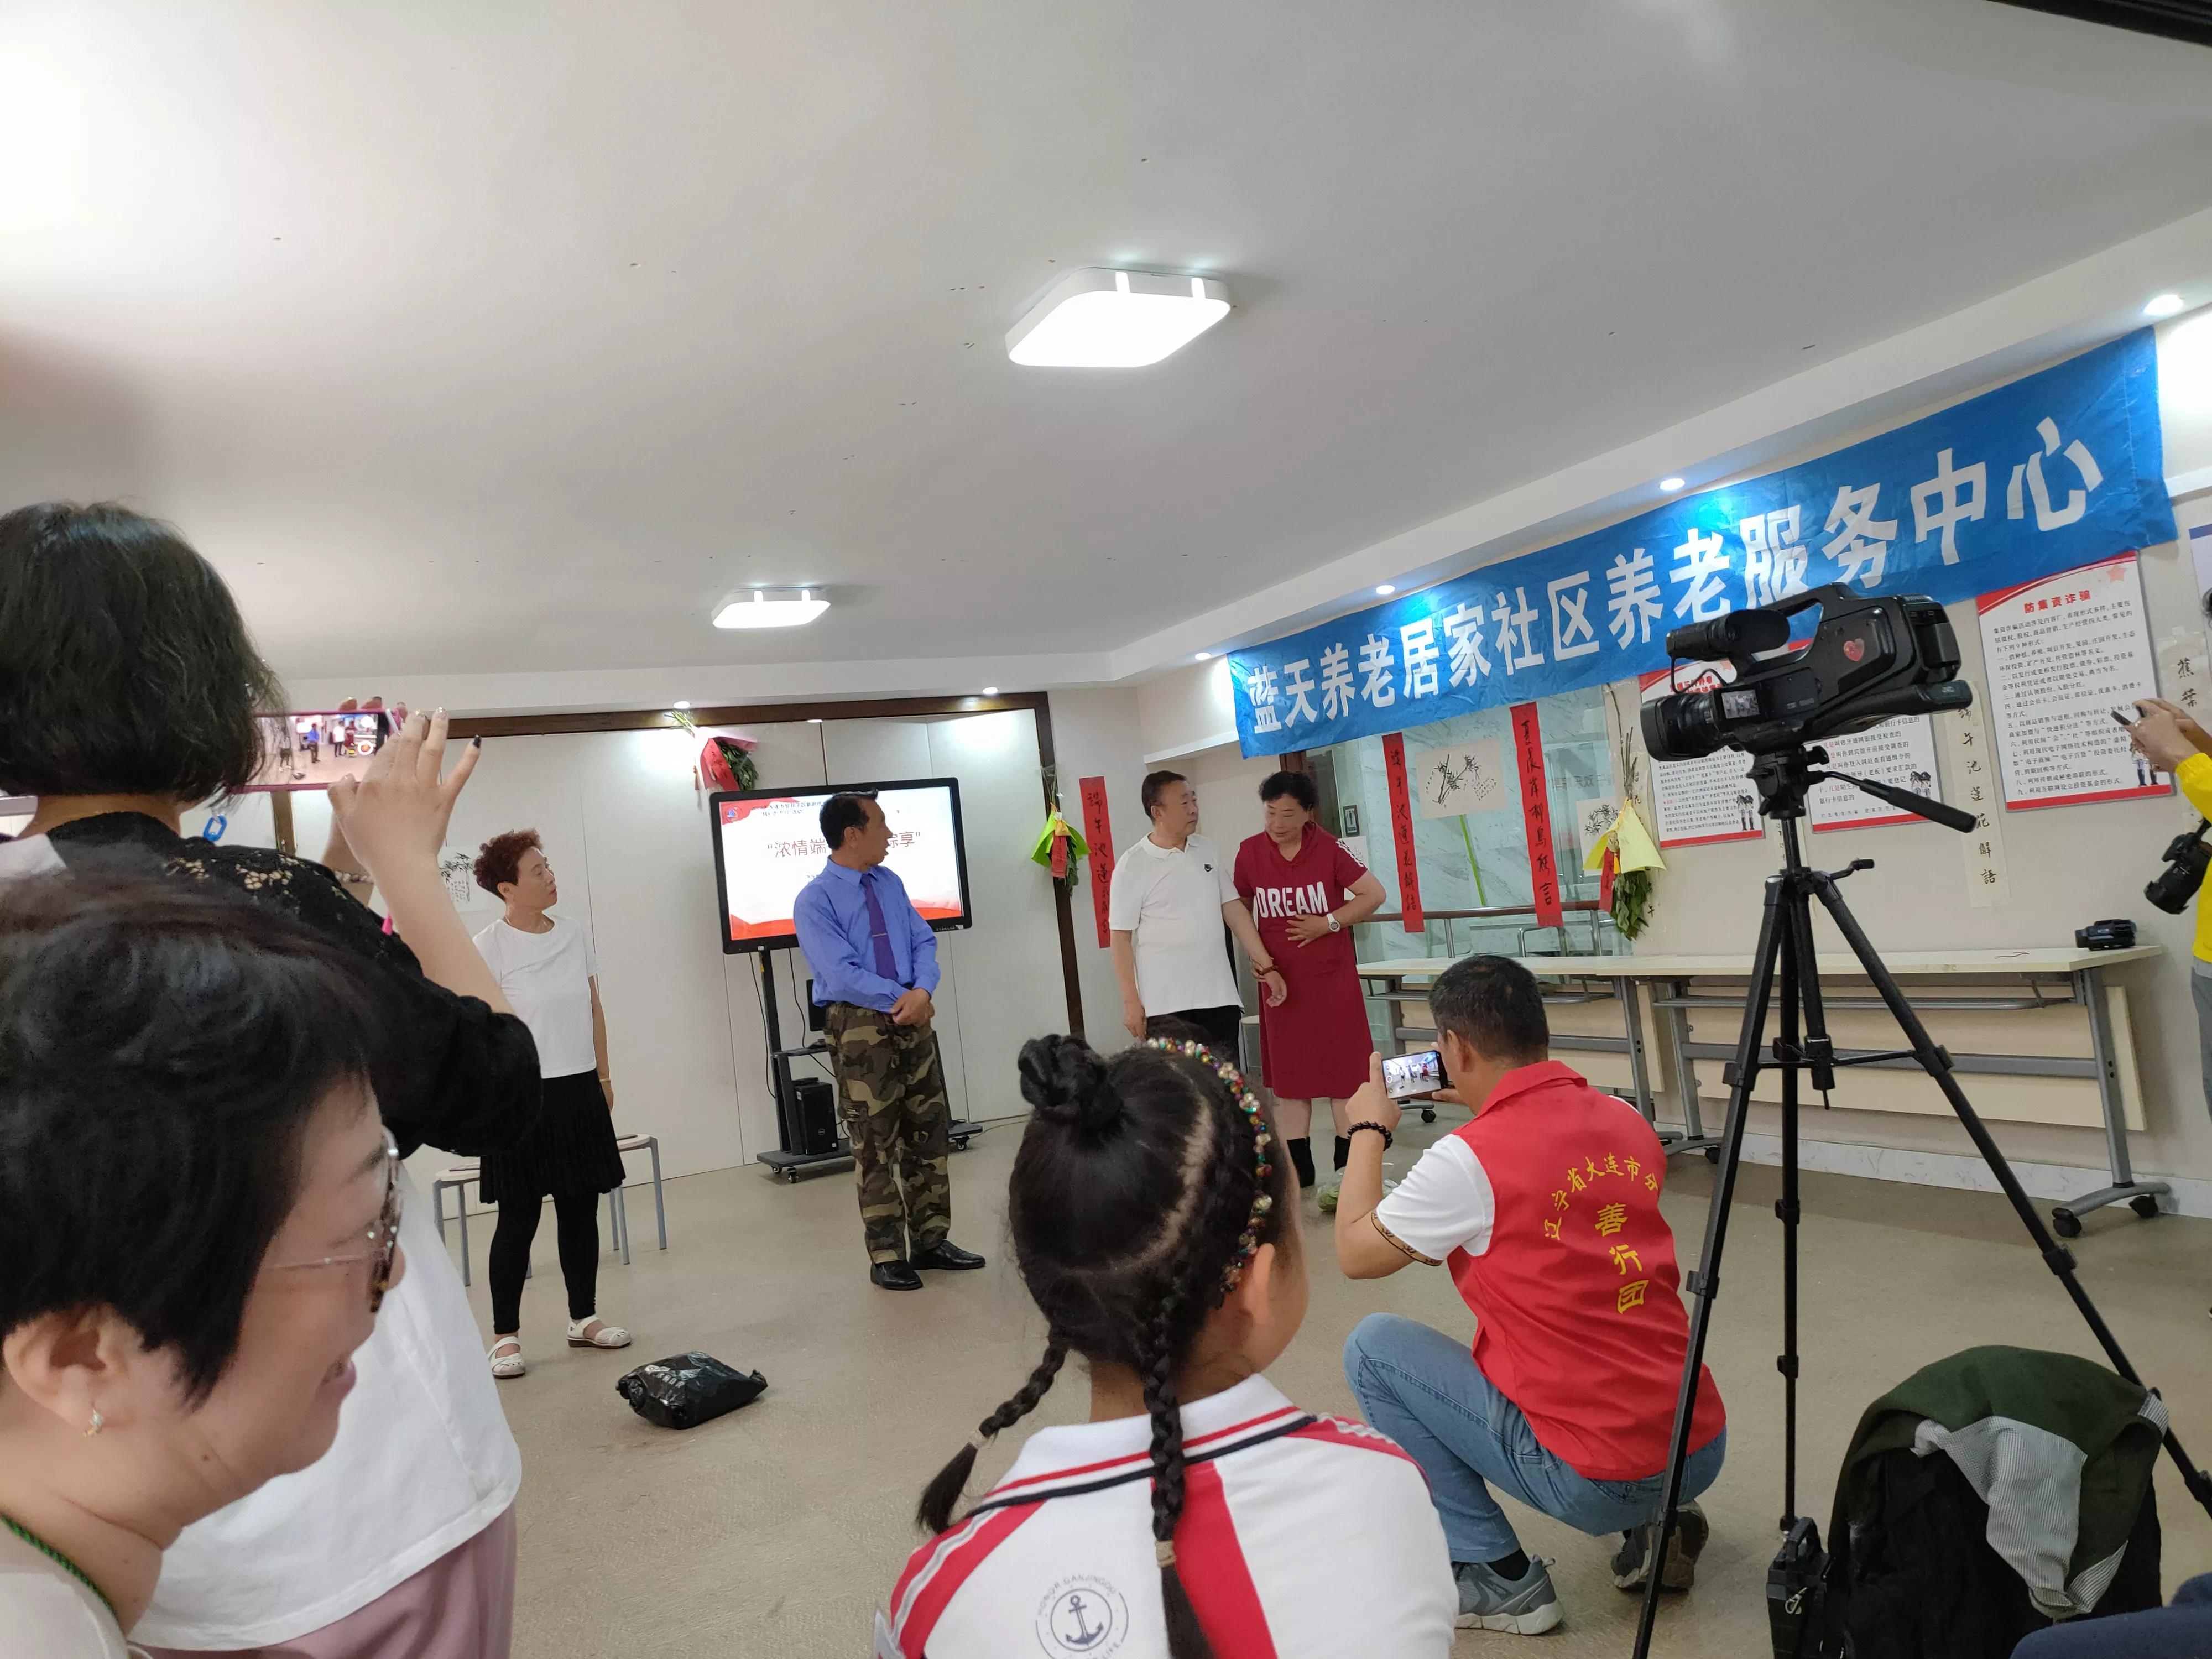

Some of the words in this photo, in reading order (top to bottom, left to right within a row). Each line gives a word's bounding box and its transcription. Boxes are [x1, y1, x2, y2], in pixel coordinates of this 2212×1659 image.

[1251, 414, 2104, 737] 蓝天养老居家社区养老服务中心
[2024, 589, 2091, 614] 防集资诈骗
[1255, 881, 1329, 919] DREAM
[1595, 1202, 1650, 1314] 善行团
